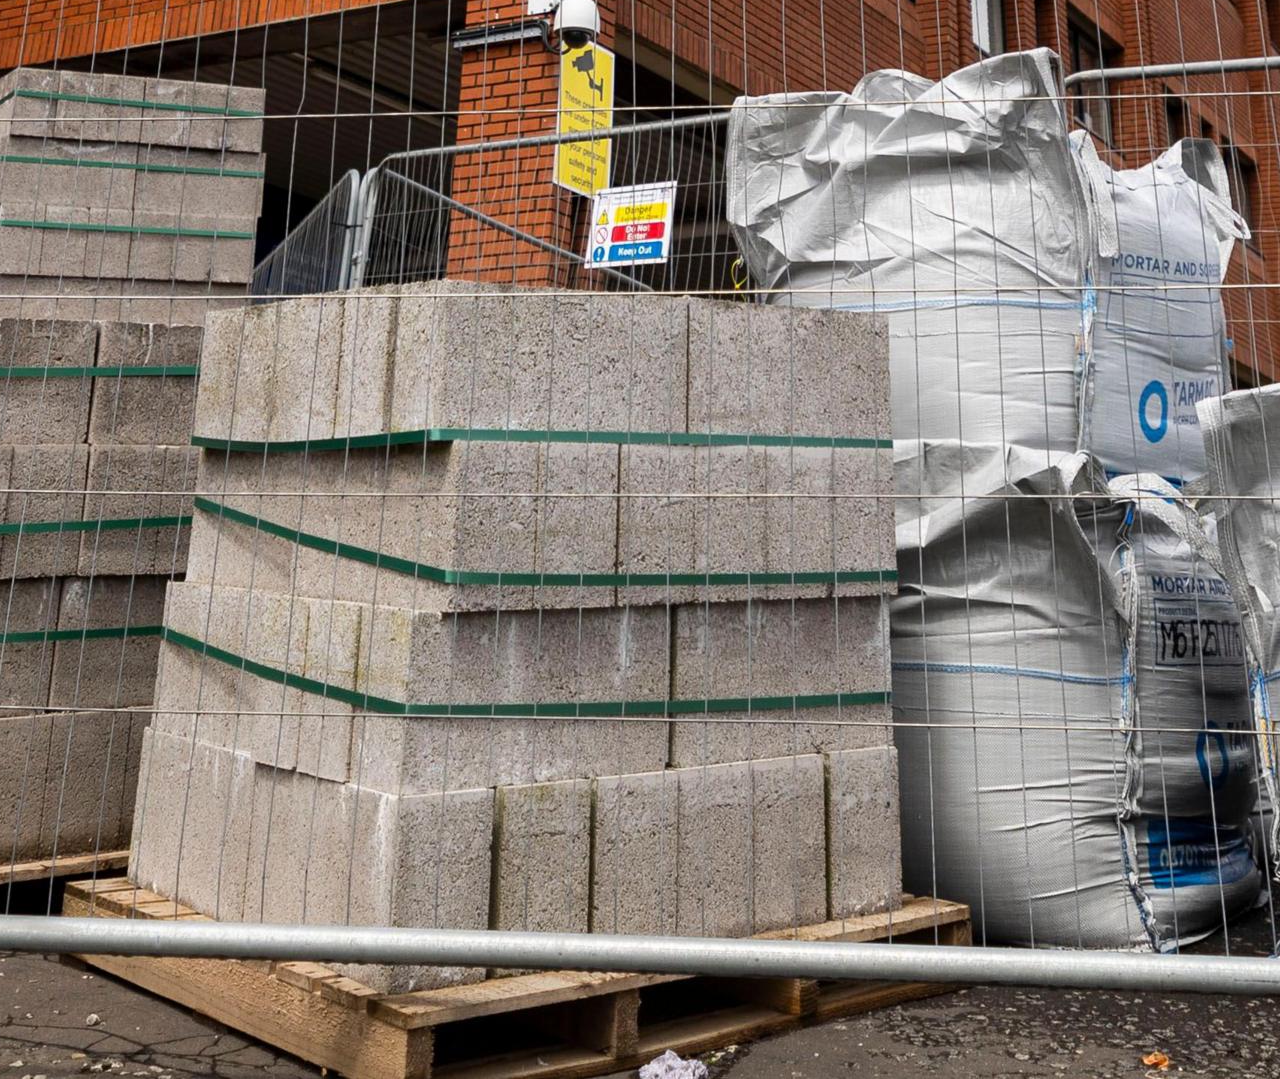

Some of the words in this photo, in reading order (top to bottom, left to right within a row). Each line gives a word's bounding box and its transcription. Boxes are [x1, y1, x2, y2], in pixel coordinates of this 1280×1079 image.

[625, 205, 653, 215] Danger
[618, 247, 637, 257] Keep
[638, 245, 652, 255] Out
[1174, 261, 1197, 277] AND
[1151, 576, 1207, 594] MORTAR
